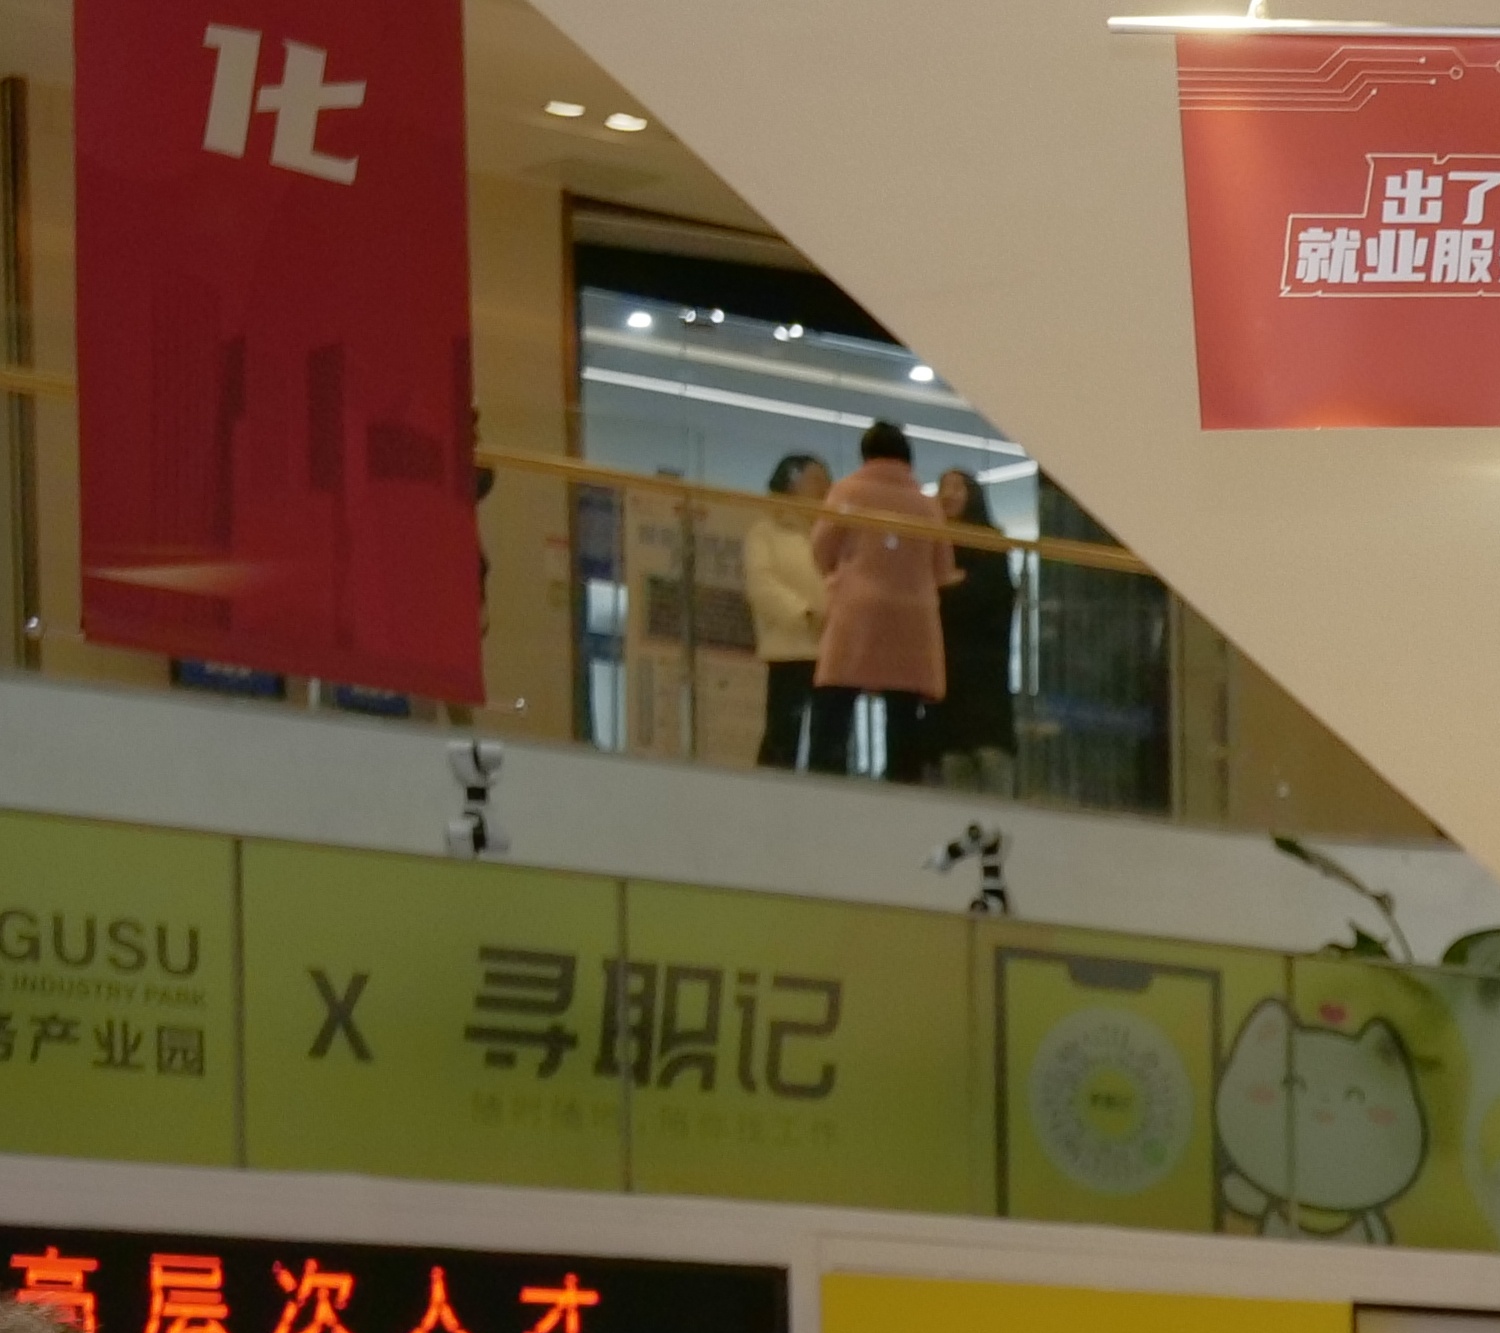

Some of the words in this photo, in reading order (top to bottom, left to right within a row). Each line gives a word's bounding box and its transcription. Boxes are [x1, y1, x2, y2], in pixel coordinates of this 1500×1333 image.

[0, 907, 200, 980] GUSU
[308, 964, 375, 1063] X
[463, 945, 843, 1101] 寻职记
